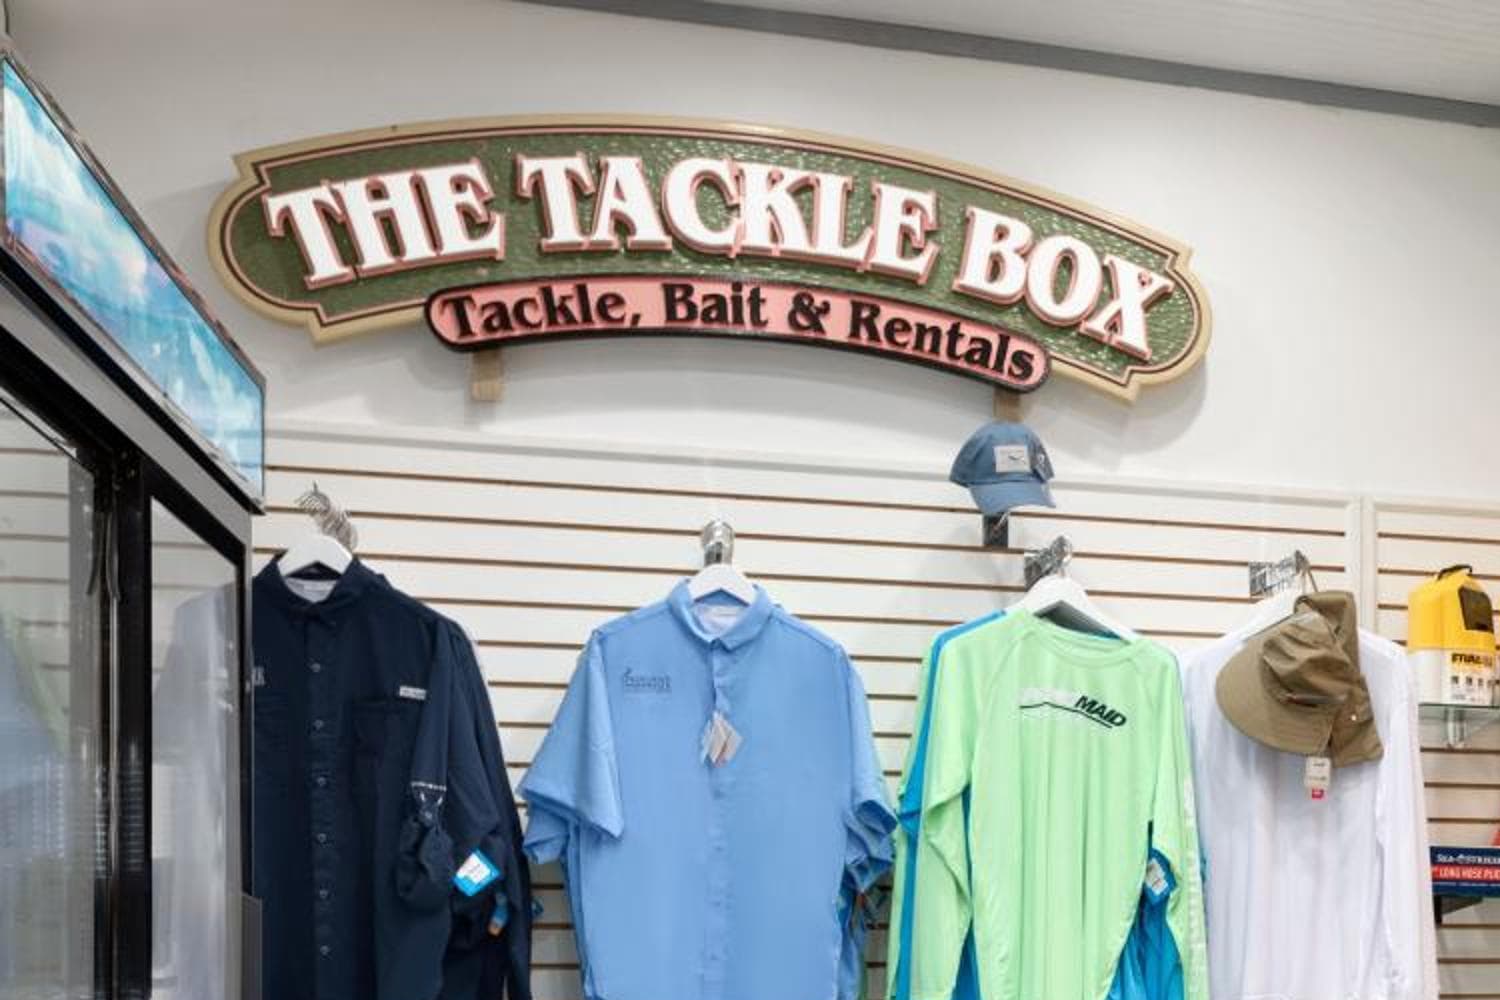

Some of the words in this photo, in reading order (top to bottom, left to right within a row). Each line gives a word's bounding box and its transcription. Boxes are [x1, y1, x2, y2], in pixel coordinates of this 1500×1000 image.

[262, 157, 505, 290] THE
[516, 153, 939, 284] TACKLE
[953, 206, 1175, 360] BOX
[439, 284, 641, 339] Tackle,
[661, 282, 769, 328] Bait
[787, 291, 831, 335] &
[848, 301, 1036, 382] Rentals
[1074, 696, 1127, 727] MAID
[1439, 867, 1461, 878] LONG
[1462, 868, 1482, 878] NOSE
